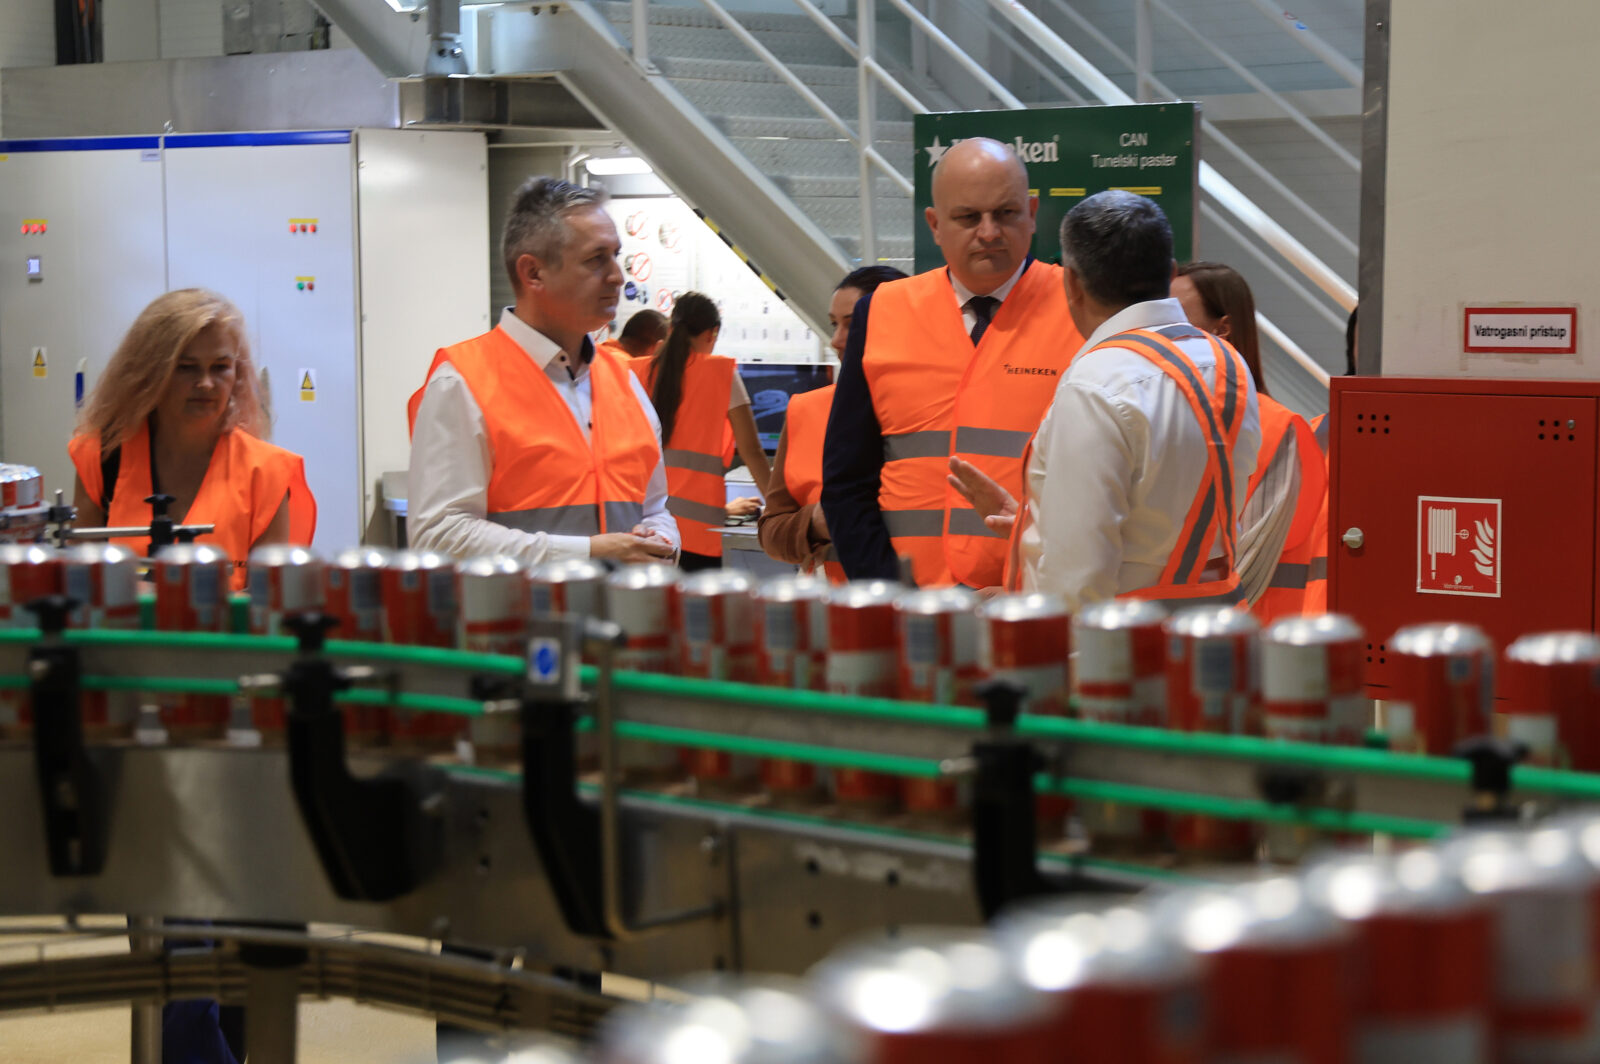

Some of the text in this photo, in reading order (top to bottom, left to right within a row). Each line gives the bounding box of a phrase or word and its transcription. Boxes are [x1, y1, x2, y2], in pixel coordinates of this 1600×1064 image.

[1119, 133, 1148, 147] CAN
[1091, 154, 1178, 170] Tunelski paster
[1474, 325, 1566, 339] Vatrogasni pristup
[1007, 367, 1057, 376] HEINEKEN
